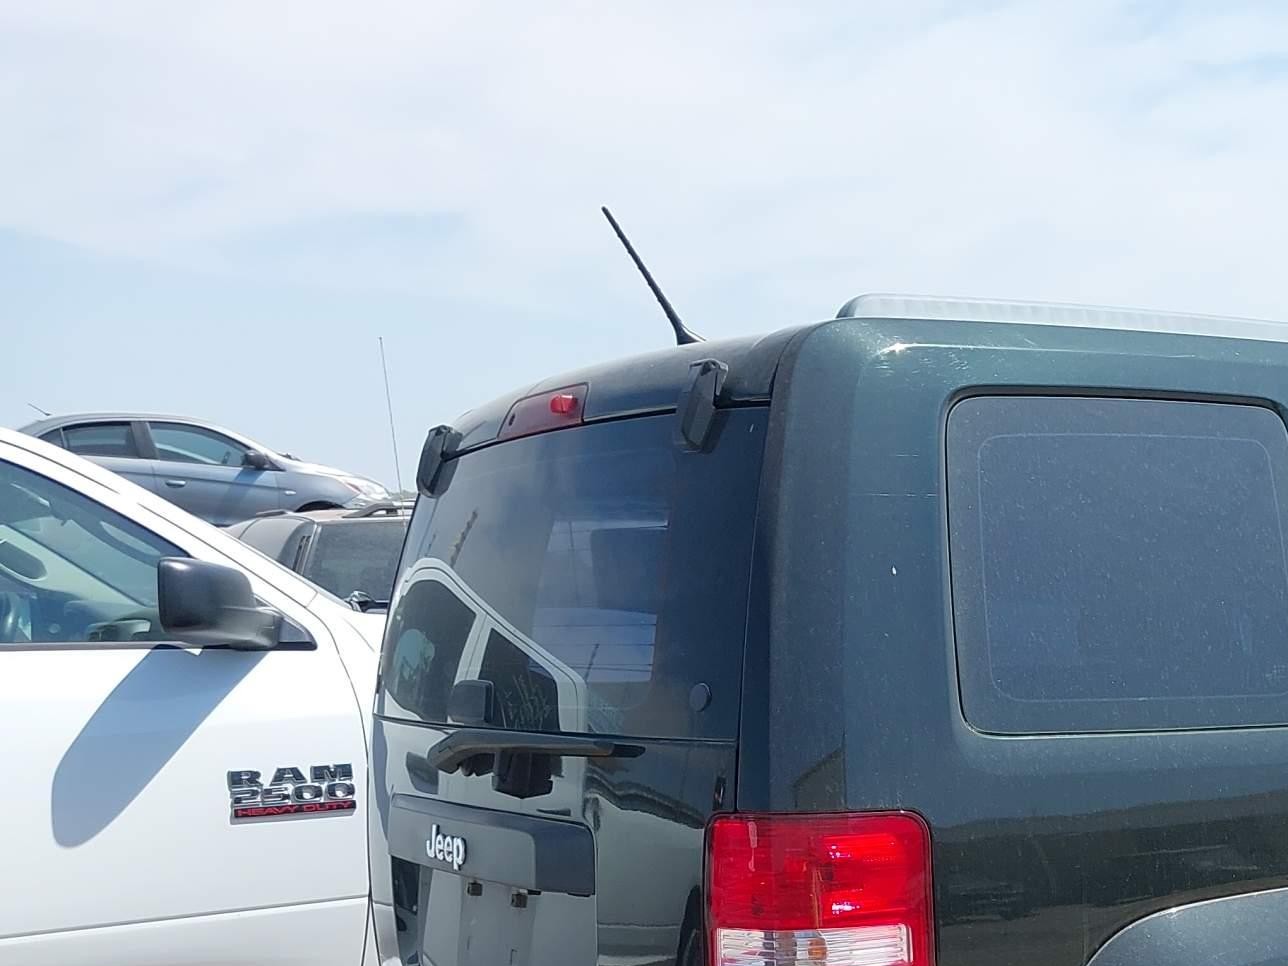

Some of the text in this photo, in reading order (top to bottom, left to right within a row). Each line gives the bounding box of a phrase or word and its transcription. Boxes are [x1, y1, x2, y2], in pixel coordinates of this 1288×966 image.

[227, 763, 353, 789] RAM
[229, 782, 356, 808] 2500
[237, 801, 352, 817] HEAVY DUTY
[426, 824, 466, 871] Jeep
